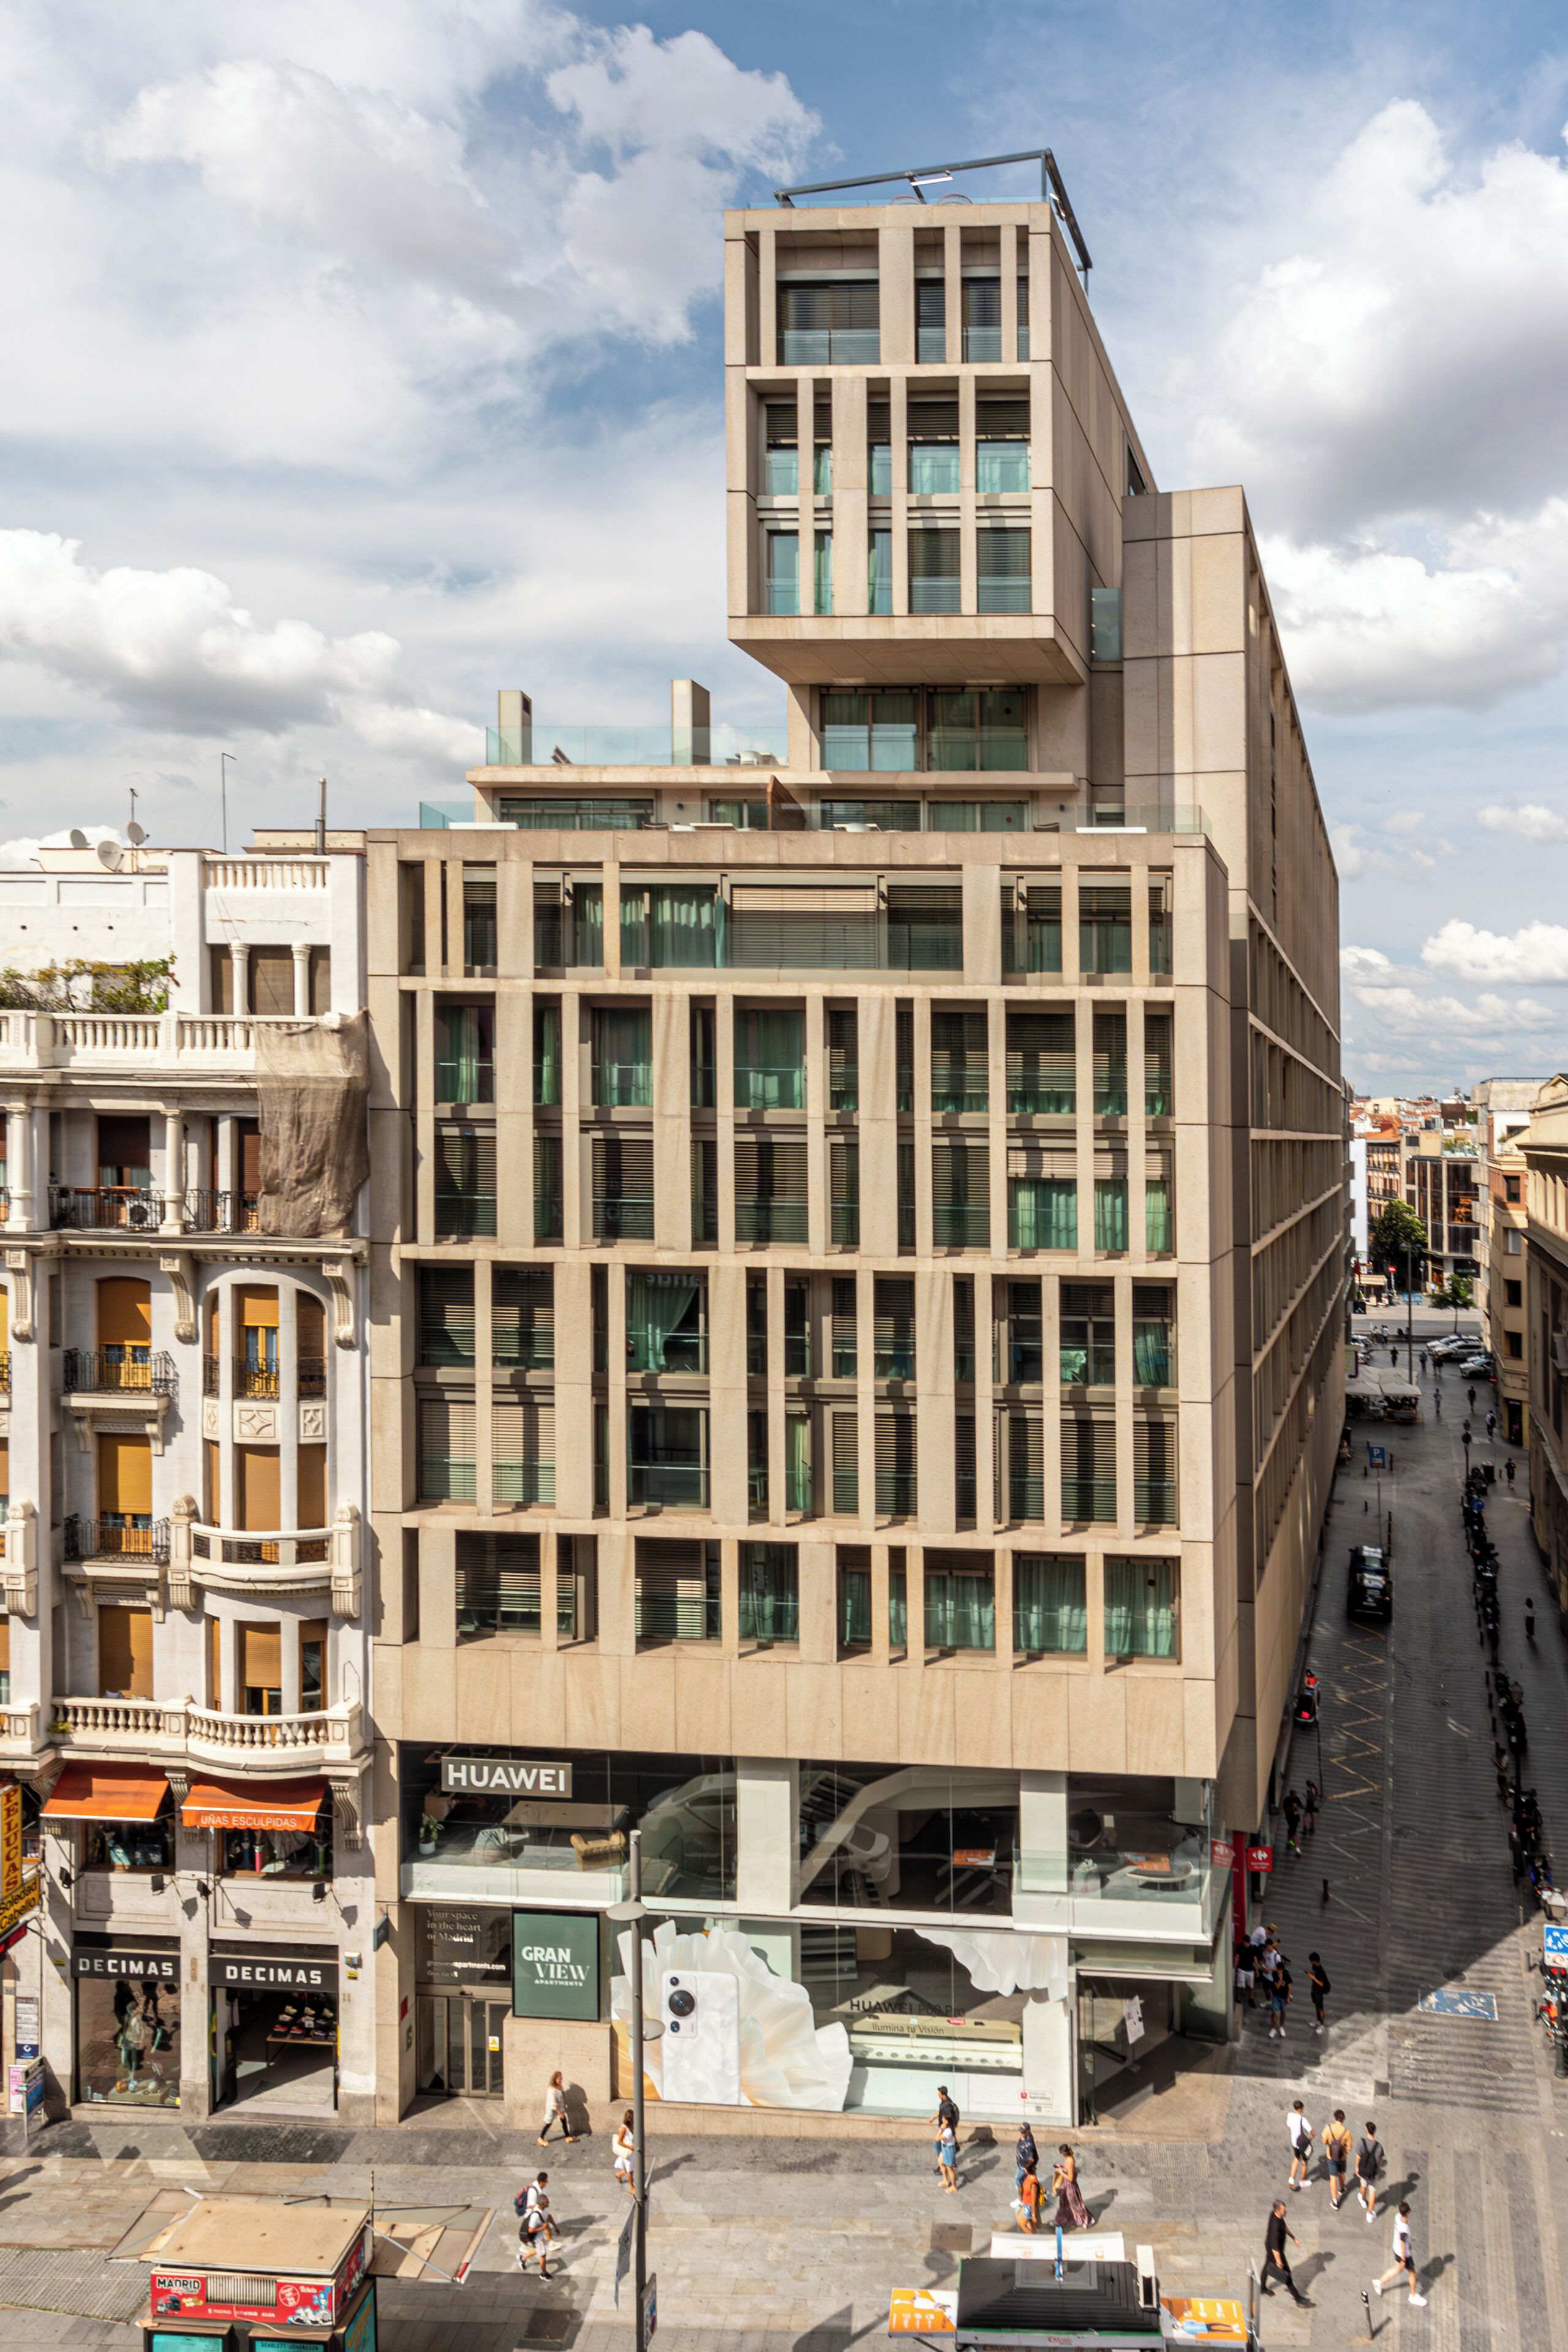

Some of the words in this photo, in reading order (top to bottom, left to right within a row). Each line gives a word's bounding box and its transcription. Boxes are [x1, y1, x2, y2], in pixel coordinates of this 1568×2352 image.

[448, 1763, 565, 1792] HUAWEI
[200, 1814, 229, 1825] UÑAS
[232, 1816, 297, 1828] ESCULPIDAS
[4, 1787, 20, 1893] PELUCAS
[0, 1877, 37, 1915] Soledad
[1, 1897, 36, 1929] Cabello
[427, 1909, 448, 1919] Your
[451, 1910, 478, 1921] space
[427, 1920, 437, 1929] in
[439, 1921, 454, 1930] the
[456, 1922, 482, 1932] heart
[427, 1931, 437, 1941] of
[439, 1932, 473, 1943] Madrid
[521, 1946, 571, 1964] GRAN
[79, 1958, 173, 1976] DECIMAS
[226, 1966, 322, 1985] DECIMAS
[535, 1962, 590, 1981] VIEW
[534, 1979, 583, 1988] APARTMENTS
[850, 1999, 913, 2014] HUAWEI
[946, 2005, 965, 2018] Pro
[872, 2022, 904, 2033] Ilumina
[919, 2025, 944, 2035] Visión
[157, 2277, 201, 2290] MADRID
